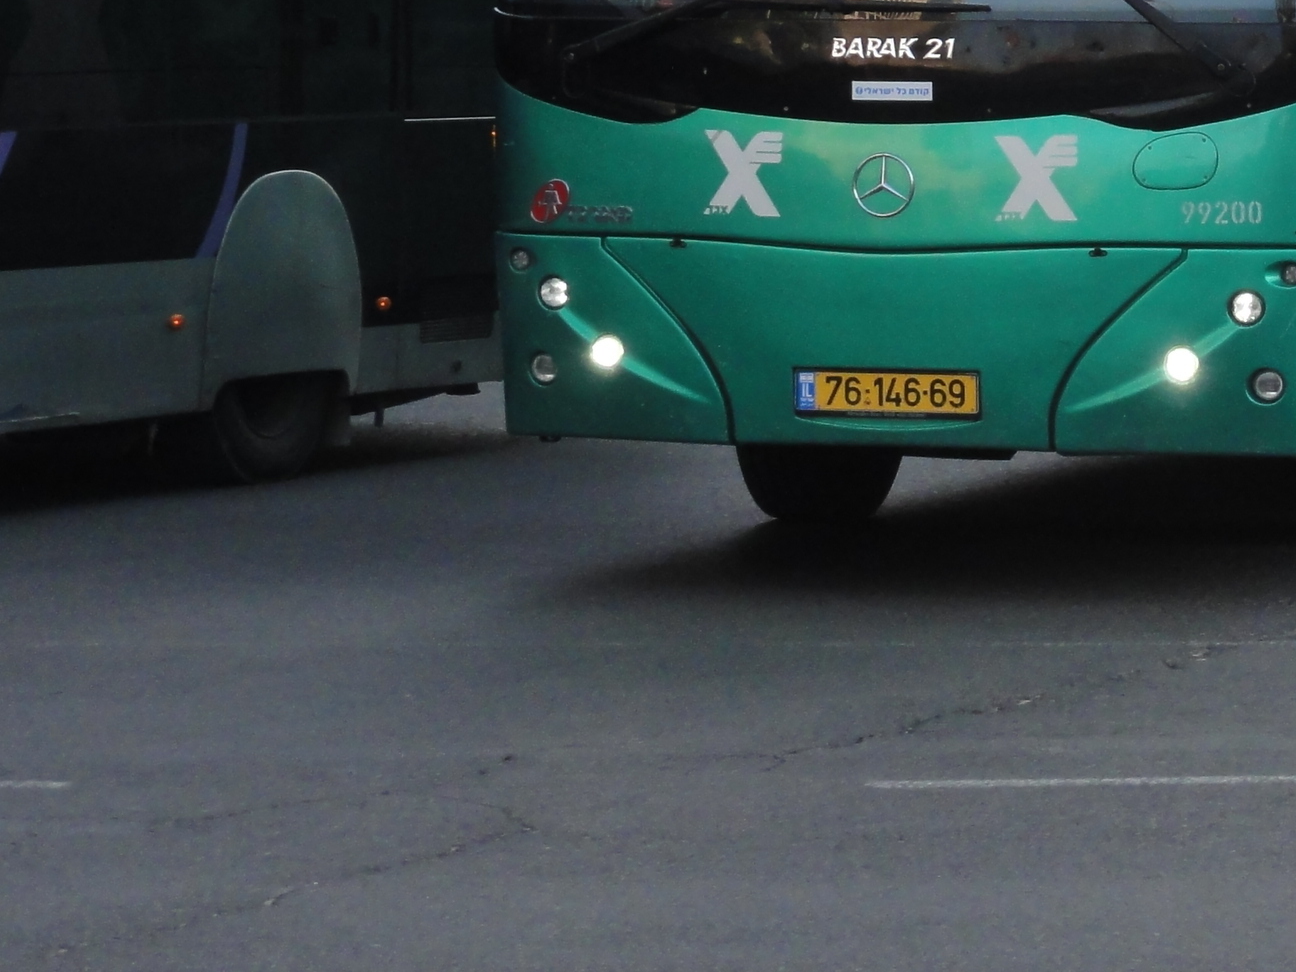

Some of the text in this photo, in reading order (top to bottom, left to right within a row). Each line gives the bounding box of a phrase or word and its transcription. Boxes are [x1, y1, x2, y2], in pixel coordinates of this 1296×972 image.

[831, 37, 956, 60] BARAK 21
[1182, 201, 1263, 224] 99200
[801, 383, 813, 397] IL
